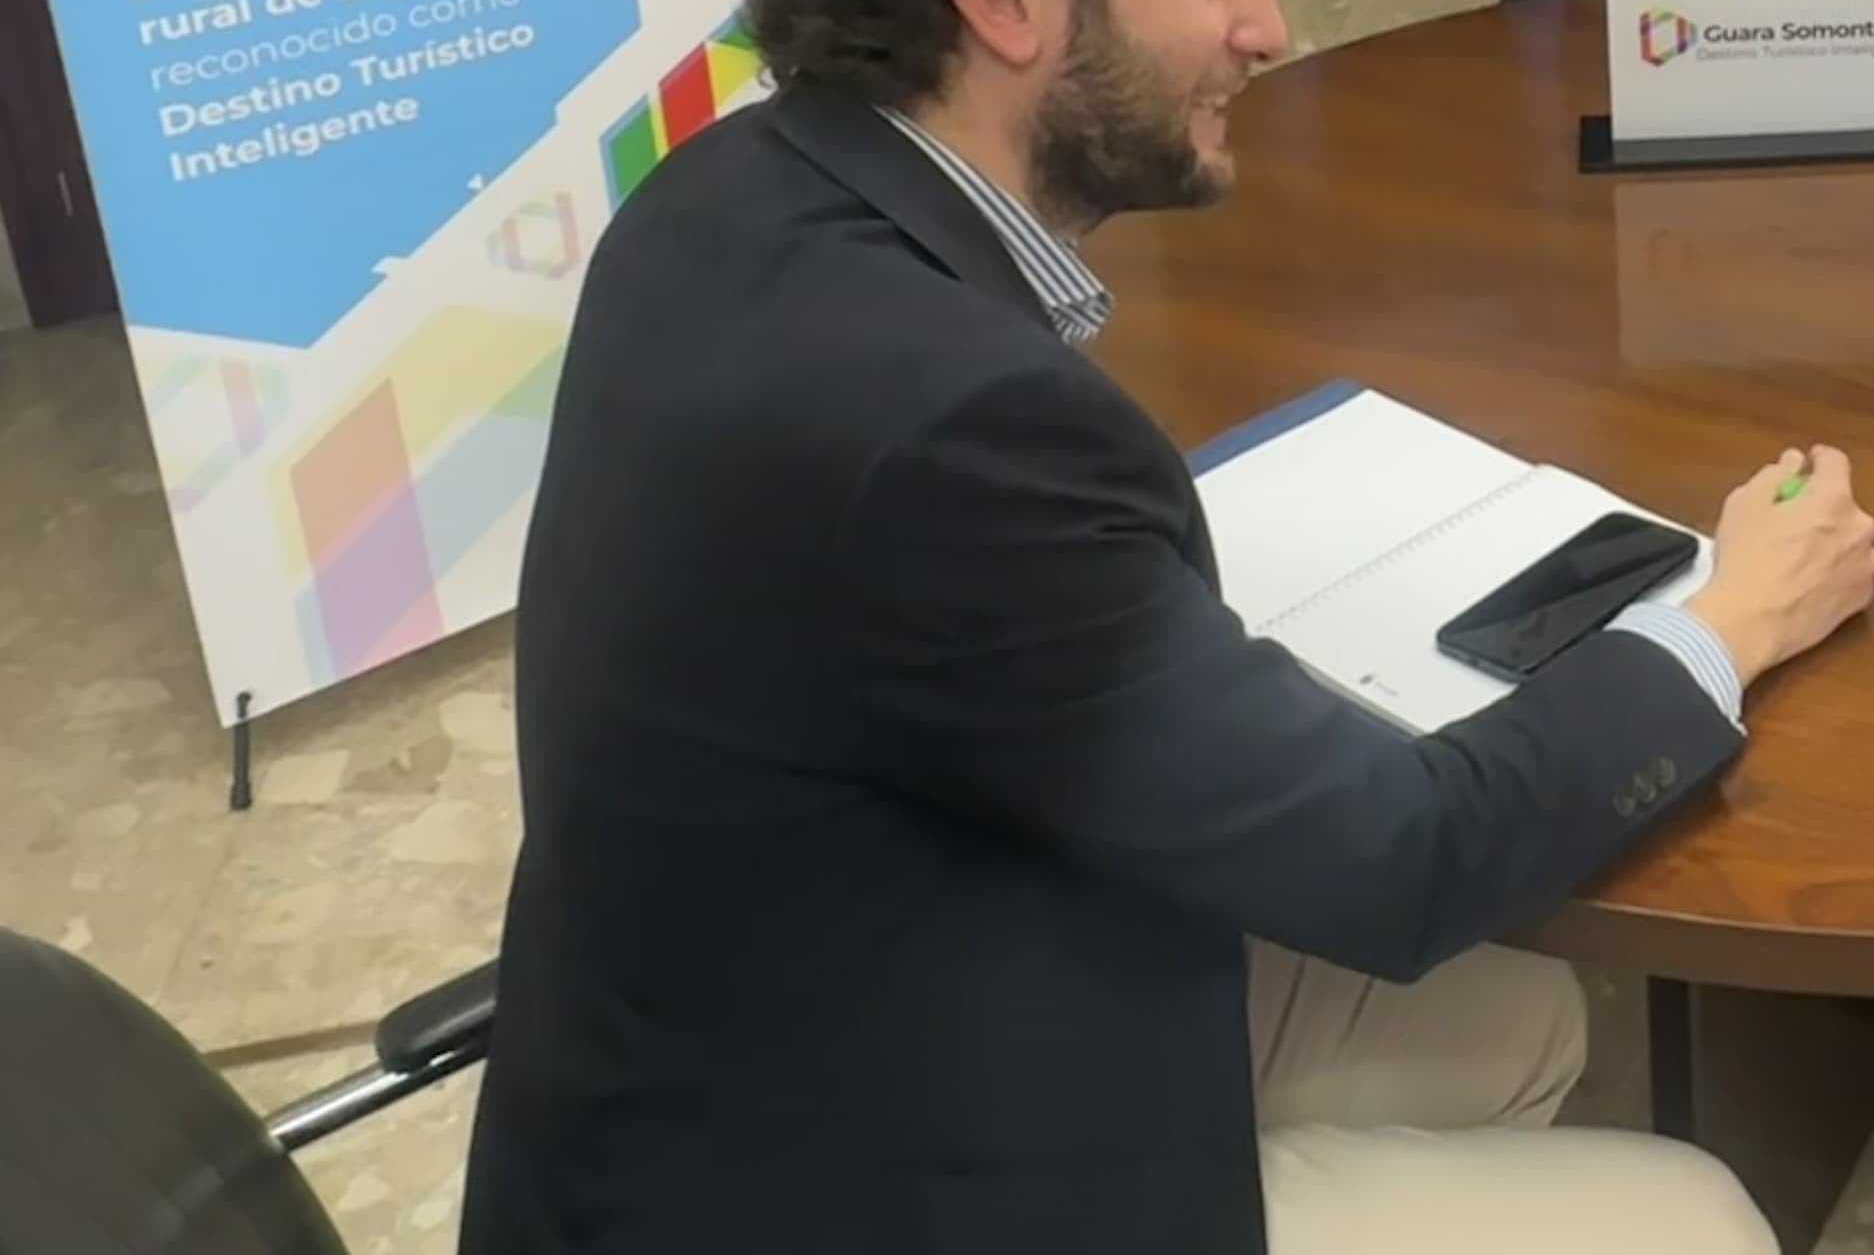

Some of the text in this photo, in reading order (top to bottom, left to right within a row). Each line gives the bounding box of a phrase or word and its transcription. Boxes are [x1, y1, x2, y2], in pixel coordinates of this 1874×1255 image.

[150, 10, 397, 90] reconocido
[1703, 24, 1775, 43] Guara
[157, 23, 535, 137] Destino Turístico
[167, 95, 420, 182] Inteligente
